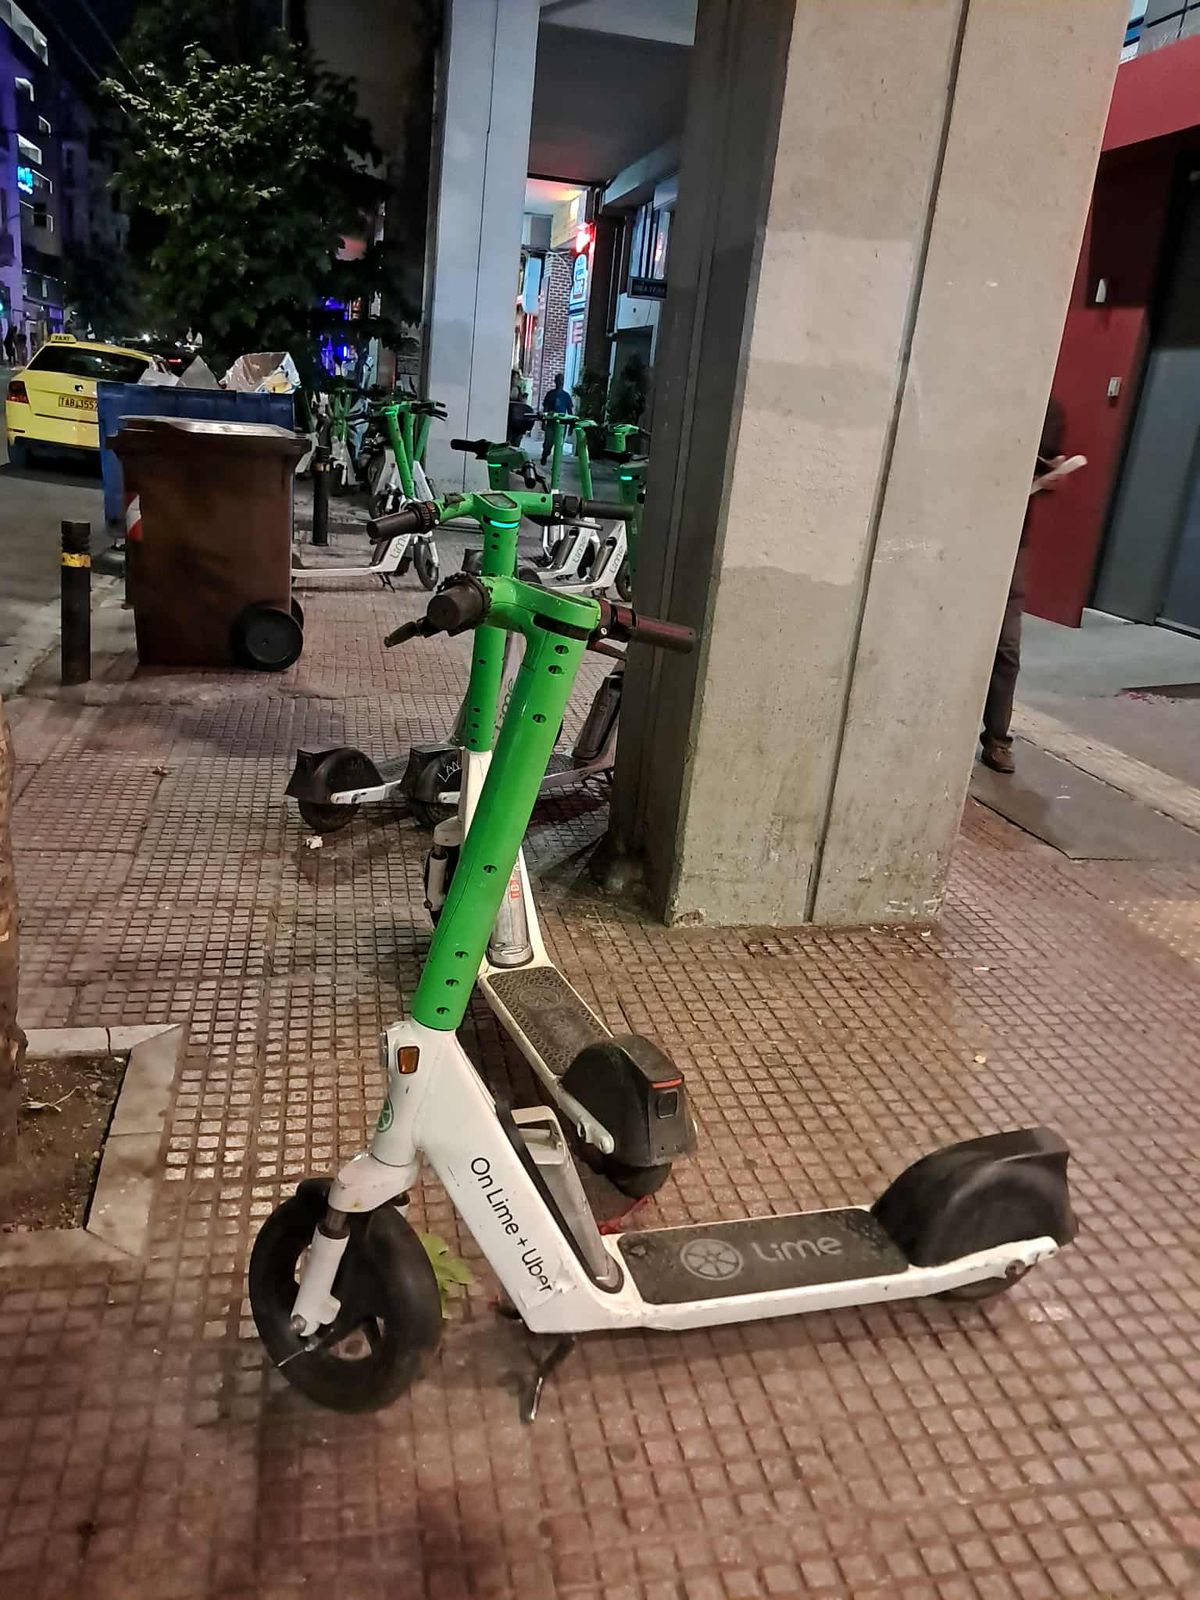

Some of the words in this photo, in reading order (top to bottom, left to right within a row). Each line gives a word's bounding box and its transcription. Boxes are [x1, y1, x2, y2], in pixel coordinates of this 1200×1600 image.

[470, 1157, 494, 1190] On
[486, 1188, 519, 1236] Lime
[517, 1237, 528, 1247] +
[750, 1236, 843, 1262] Lime
[521, 1248, 553, 1293] Uber
